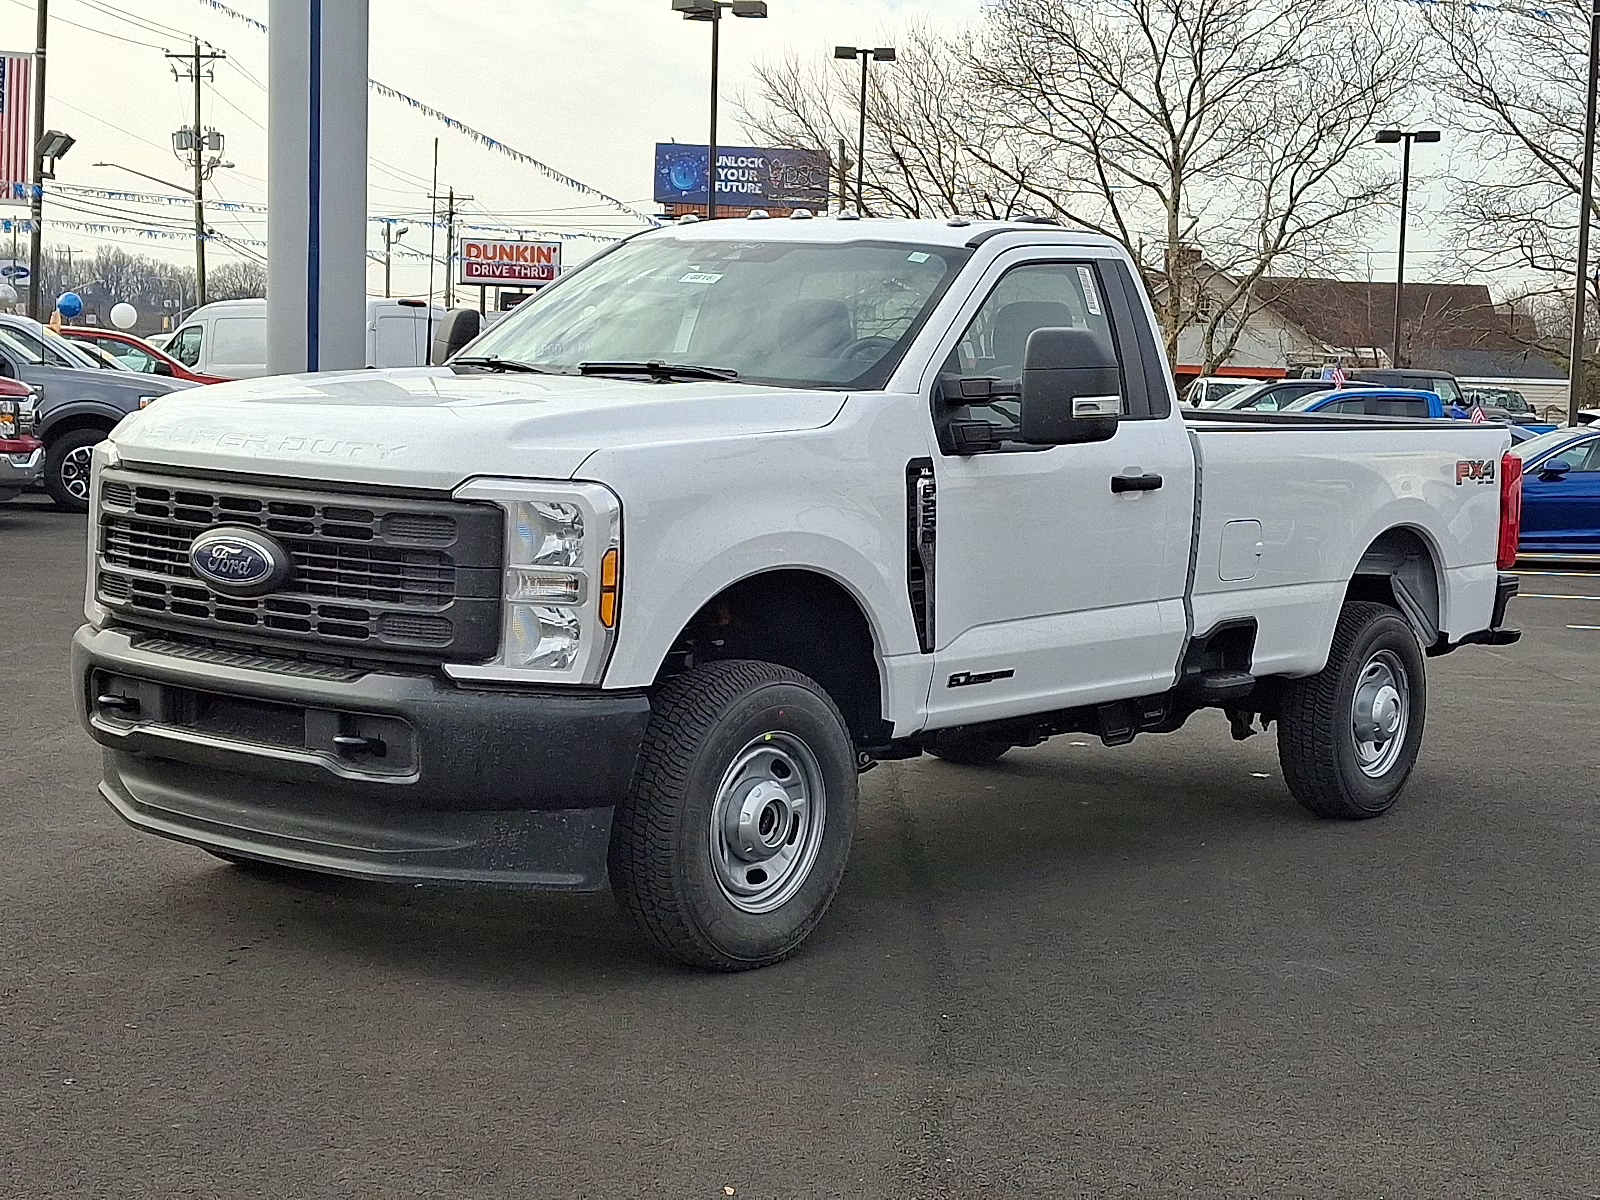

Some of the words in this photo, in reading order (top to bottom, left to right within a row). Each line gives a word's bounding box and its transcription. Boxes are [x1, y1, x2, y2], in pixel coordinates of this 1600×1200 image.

[715, 155, 764, 168] UNLOCK
[717, 168, 760, 182] YOUR
[715, 181, 763, 194] FUTURE
[465, 243, 557, 264] DUNKIN'
[472, 264, 510, 276] DRIVE
[512, 266, 548, 278] THRU
[144, 426, 271, 450] SUPER
[277, 436, 409, 460] DUTY
[920, 467, 933, 475] XL
[1455, 460, 1495, 485] FX4
[207, 545, 253, 576] Ford
